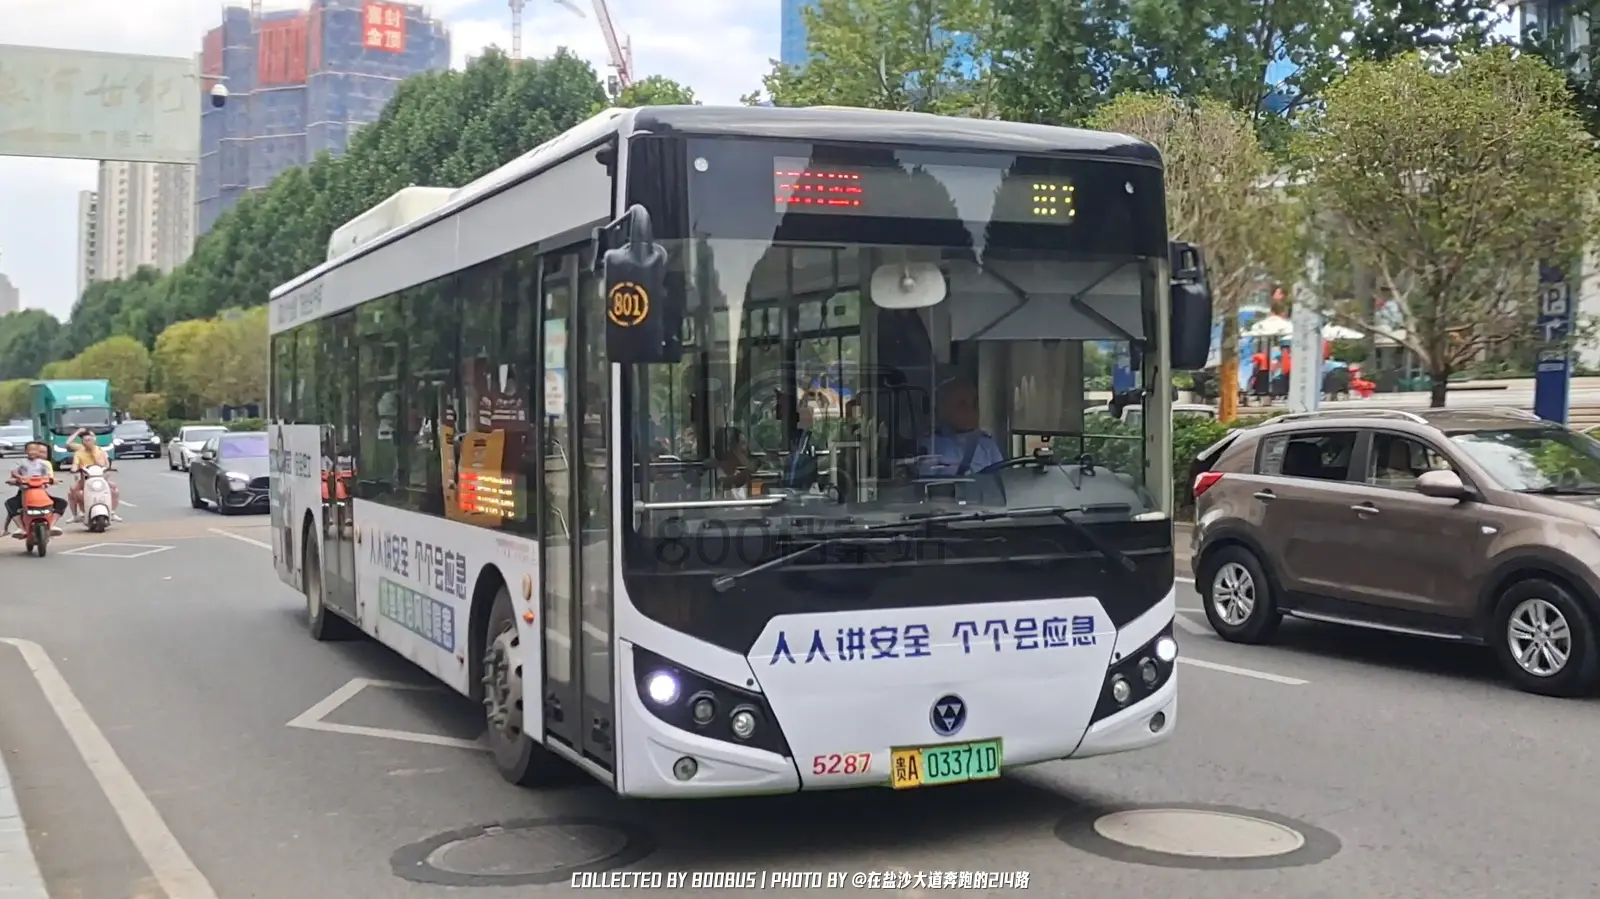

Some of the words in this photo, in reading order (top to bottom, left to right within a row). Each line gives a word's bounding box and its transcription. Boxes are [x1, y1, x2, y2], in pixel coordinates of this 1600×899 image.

[614, 292, 641, 316] 801
[414, 540, 467, 600] 个个会应急
[769, 623, 932, 665] 人人讲安全
[952, 615, 1097, 654] 个个会应急
[812, 752, 872, 776] 5287
